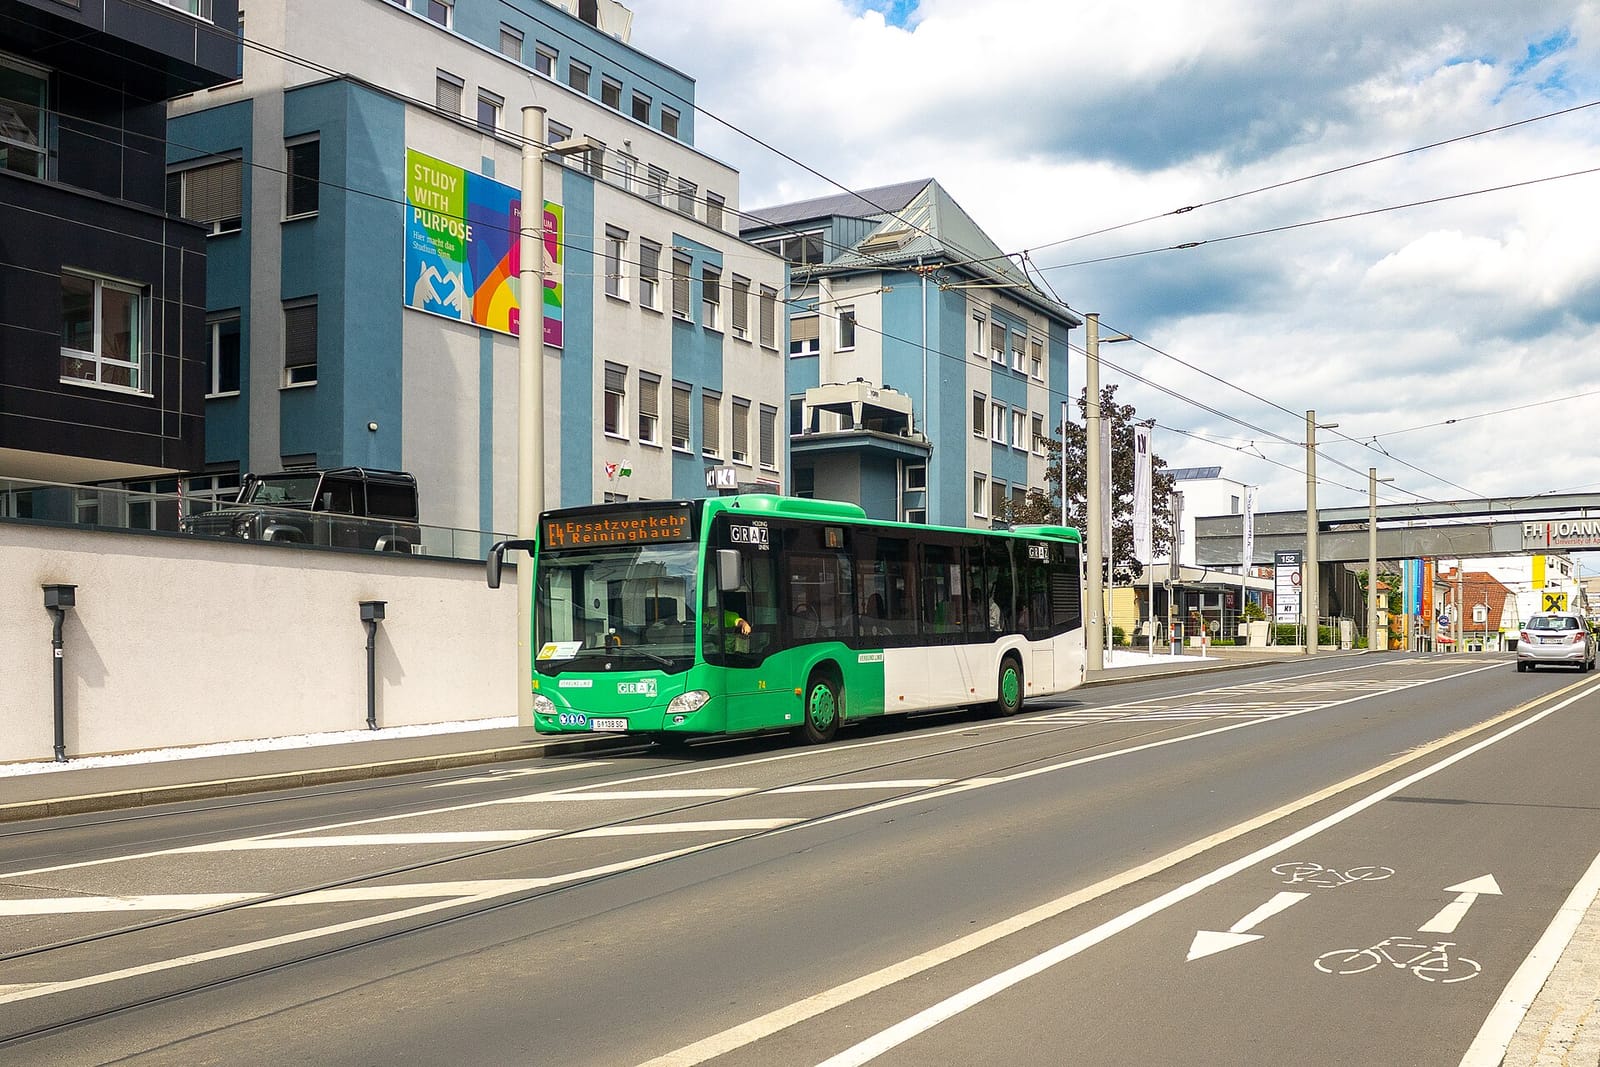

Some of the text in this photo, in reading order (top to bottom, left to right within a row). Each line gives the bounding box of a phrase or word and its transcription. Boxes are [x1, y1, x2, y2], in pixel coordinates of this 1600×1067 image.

[414, 164, 457, 193] STUDY
[414, 185, 449, 212] WITH
[414, 207, 473, 242] PURPOSE
[412, 241, 436, 255] Studium
[413, 230, 455, 252] Hier macht das
[717, 468, 735, 486] K1
[566, 515, 687, 533] Ersatzverkehr
[1524, 523, 1543, 537] FH
[548, 523, 564, 547] E4
[572, 527, 681, 543] Reininghaus
[732, 526, 768, 543] GRAZ
[1555, 538, 1584, 546] University
[1029, 546, 1049, 559] GRAZ
[1281, 555, 1296, 563] 152
[619, 683, 656, 693] GRAZ
